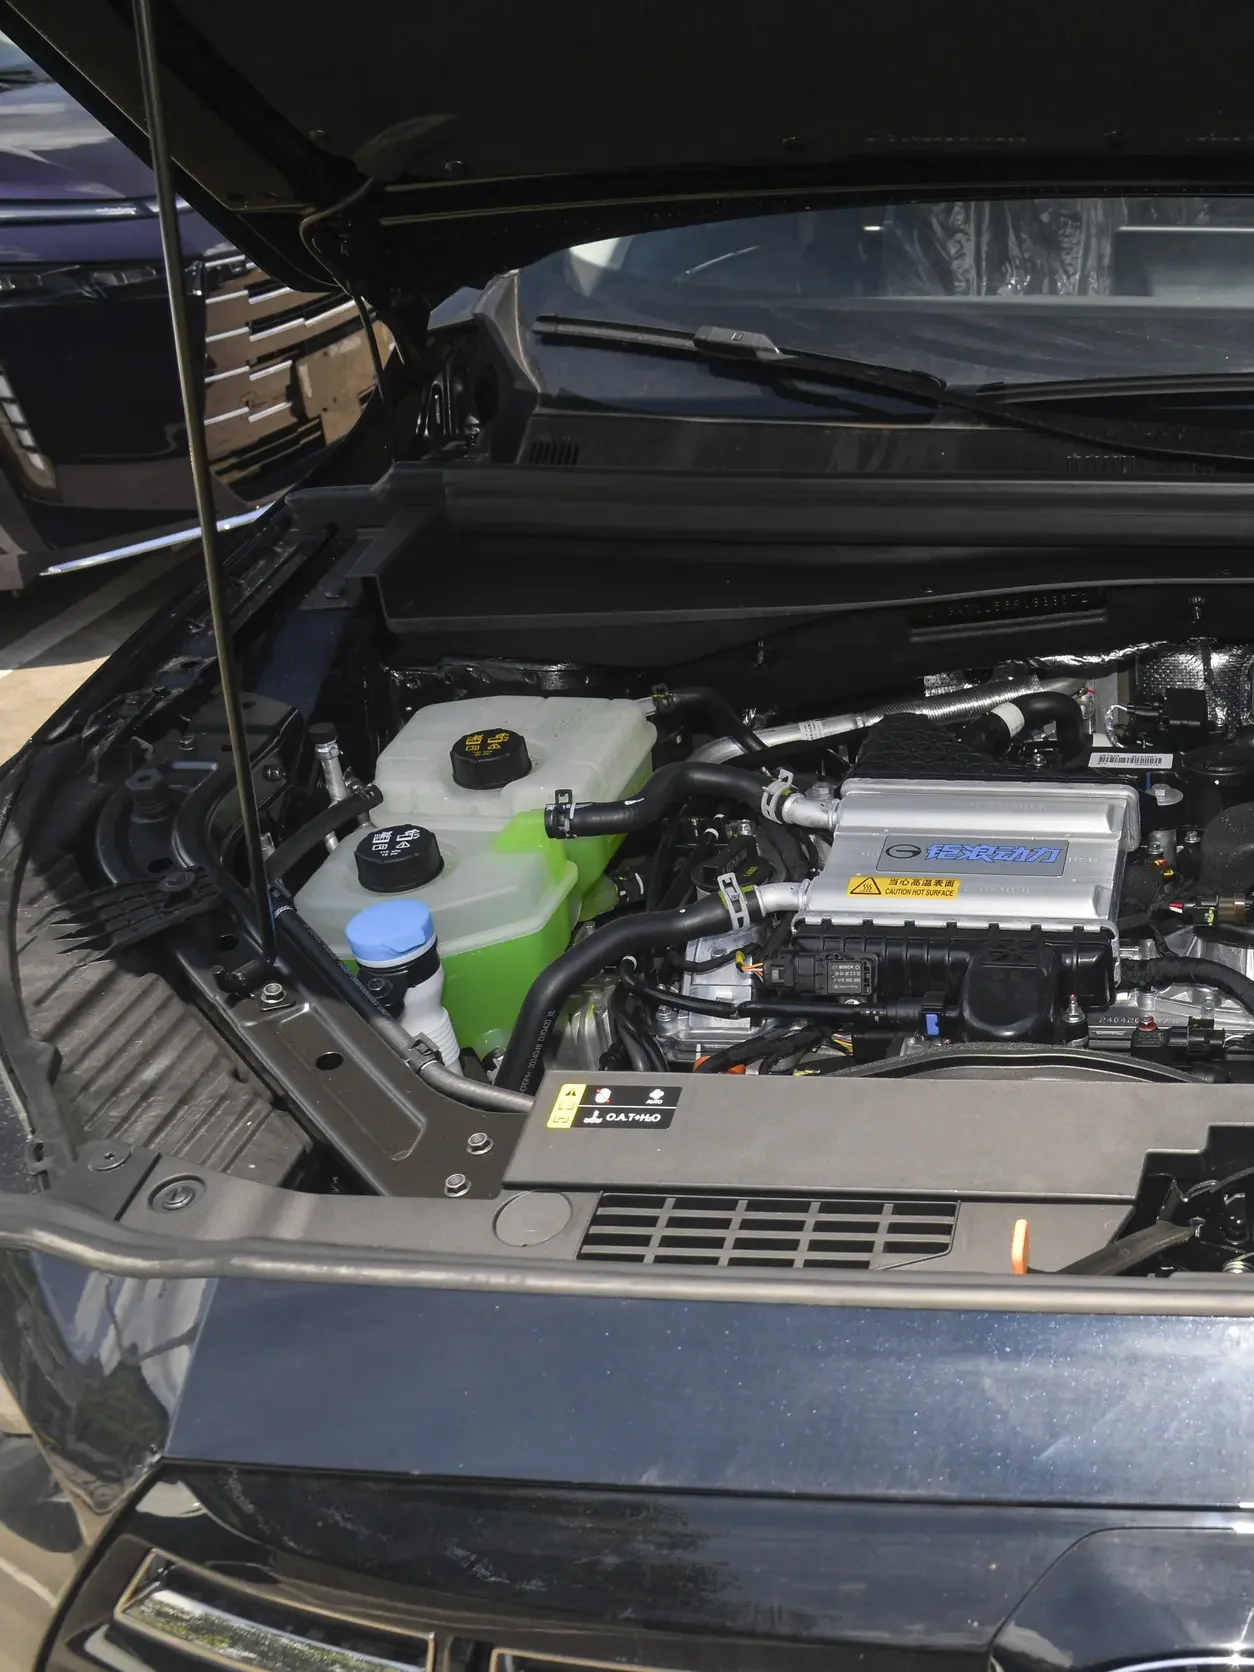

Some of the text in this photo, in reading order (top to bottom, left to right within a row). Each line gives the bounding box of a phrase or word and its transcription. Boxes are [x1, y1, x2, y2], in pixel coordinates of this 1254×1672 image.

[888, 878, 955, 888] 当心高温表面
[885, 888, 954, 897] CAUTION HOT SURFACE
